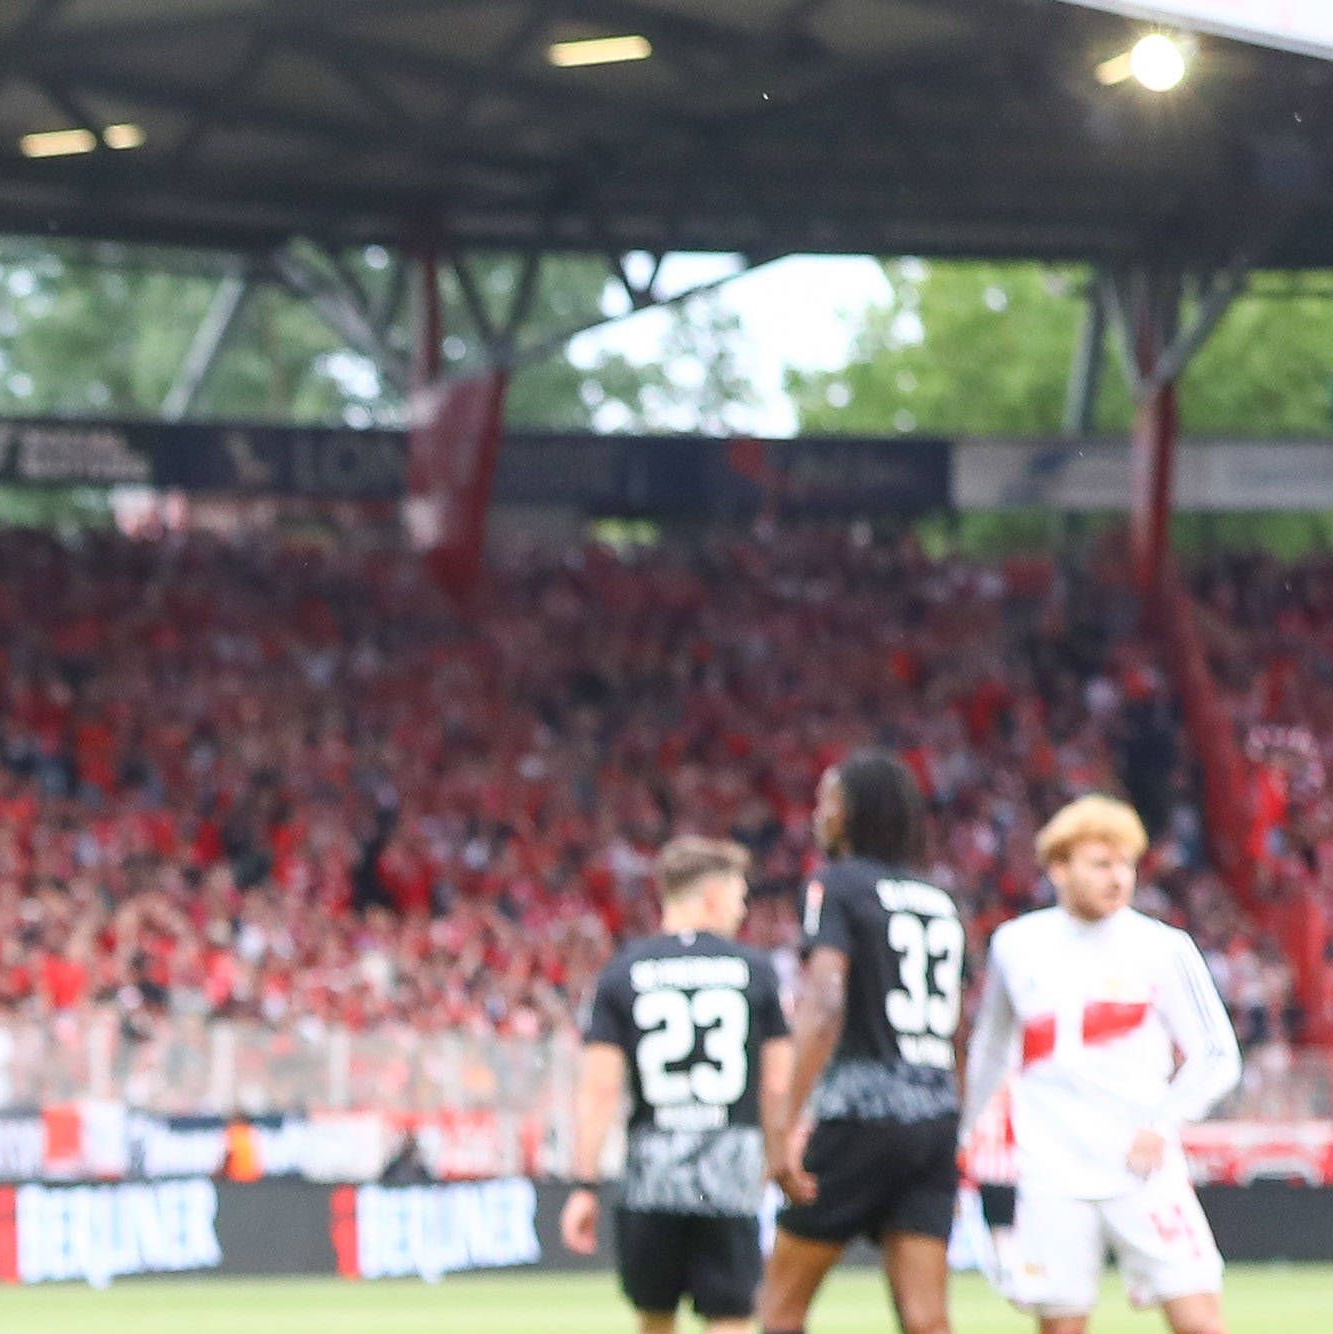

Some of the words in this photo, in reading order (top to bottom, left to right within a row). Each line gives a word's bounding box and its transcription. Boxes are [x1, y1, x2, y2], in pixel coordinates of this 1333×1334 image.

[885, 912, 965, 1039] 33
[633, 988, 750, 1105] 23
[17, 1176, 223, 1289] BERLINER
[356, 1176, 541, 1284] BERLINER
